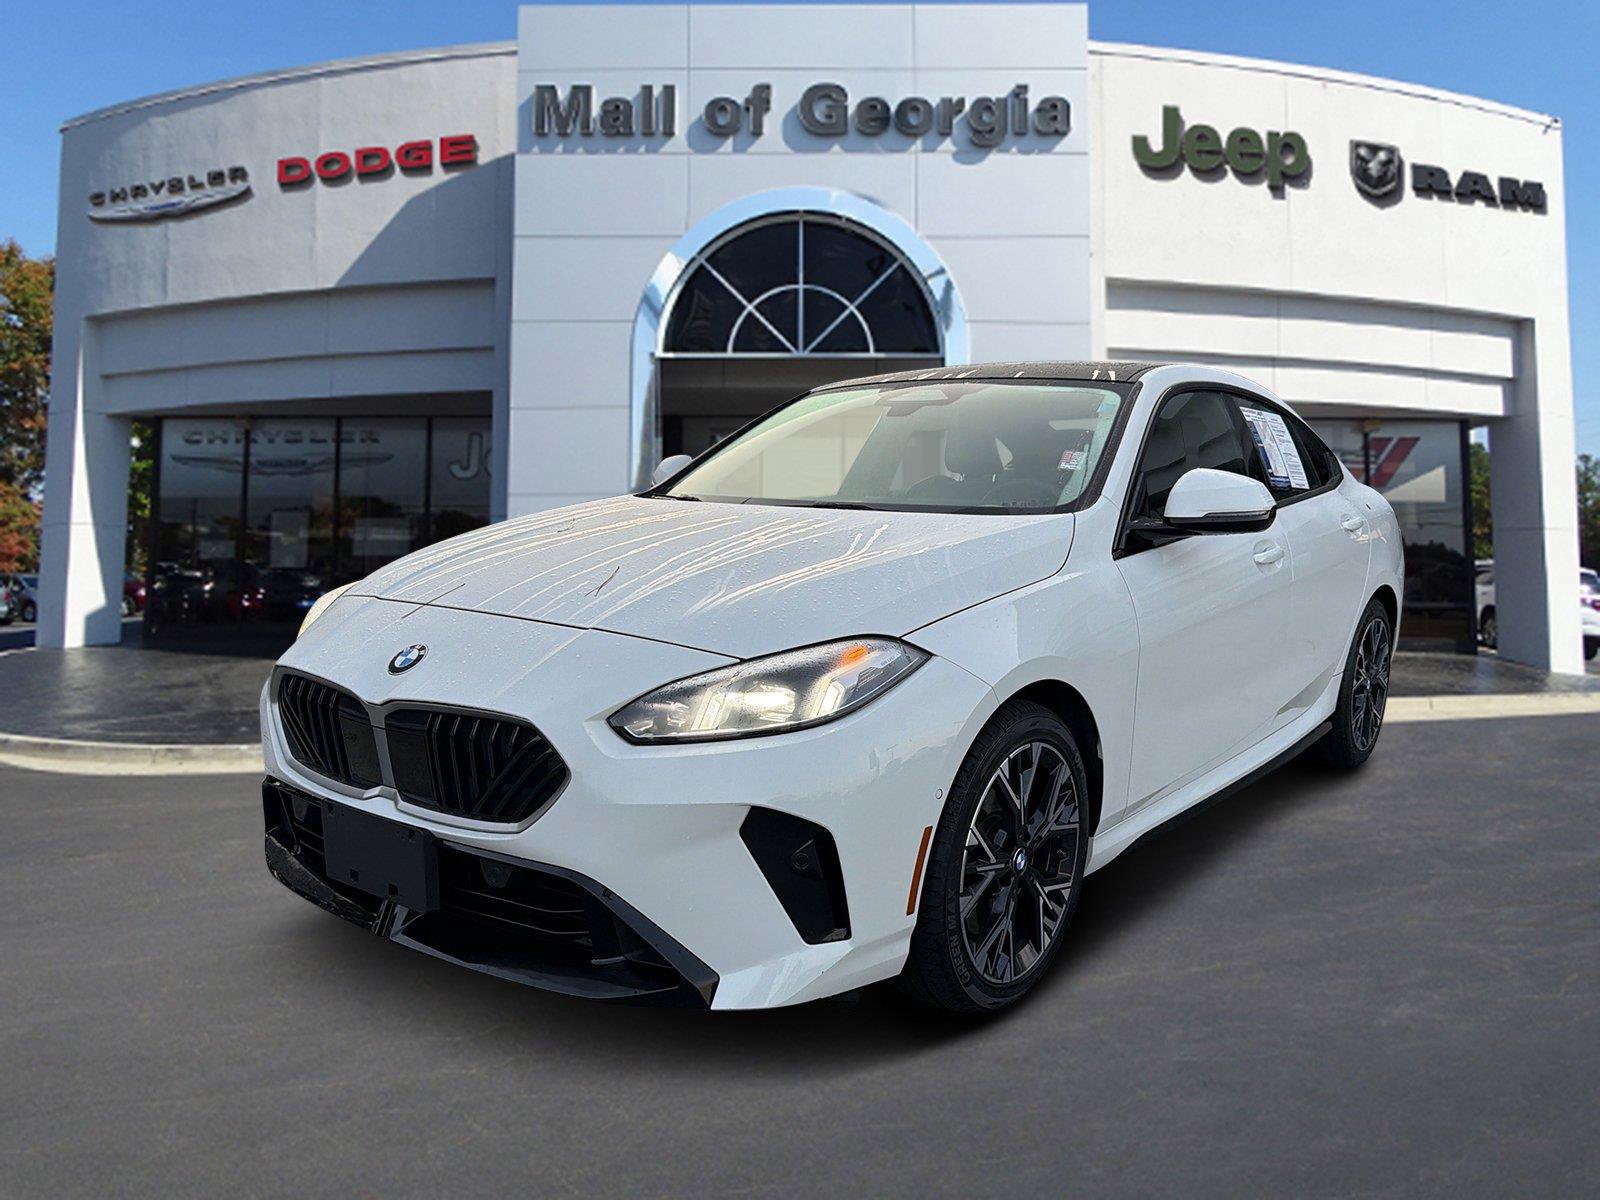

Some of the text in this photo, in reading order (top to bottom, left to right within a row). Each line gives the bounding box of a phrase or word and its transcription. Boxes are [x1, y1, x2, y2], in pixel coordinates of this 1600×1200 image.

[532, 82, 1073, 147] Mall of Georgia
[276, 134, 477, 187] DODGE
[1131, 105, 1311, 193] Jeep
[89, 166, 249, 207] CHRYSLER
[1411, 163, 1547, 213] RAM
